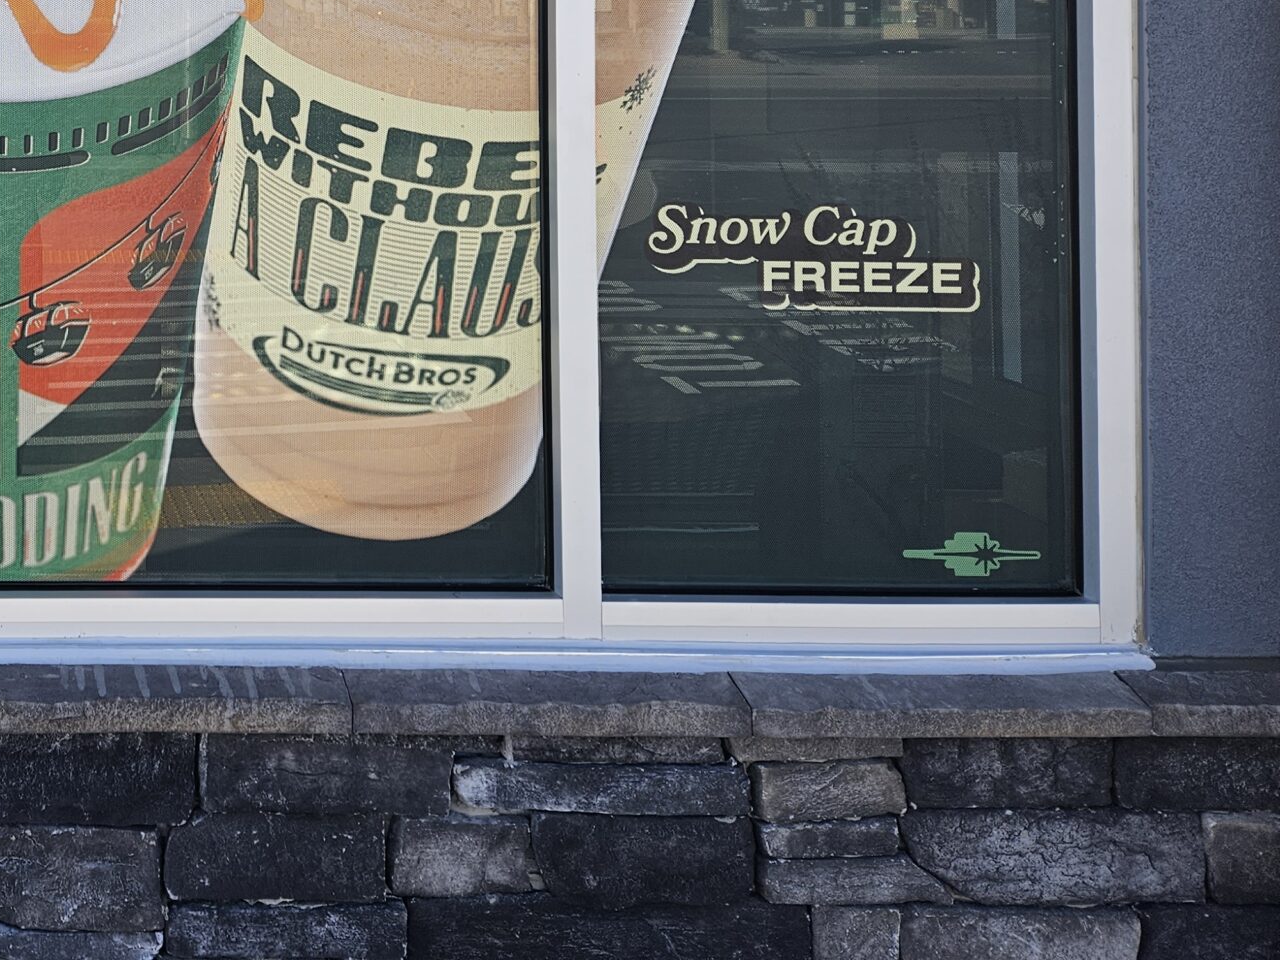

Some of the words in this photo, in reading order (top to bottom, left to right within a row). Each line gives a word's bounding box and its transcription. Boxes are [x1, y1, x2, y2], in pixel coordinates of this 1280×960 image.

[239, 107, 540, 227] WITHOU
[241, 54, 540, 191] REBE
[231, 156, 260, 280] A
[648, 204, 791, 254] Snow
[803, 206, 898, 255] Cap
[763, 261, 963, 294] FREEZE
[281, 325, 386, 382] DUTCH
[393, 360, 477, 386] BROS
